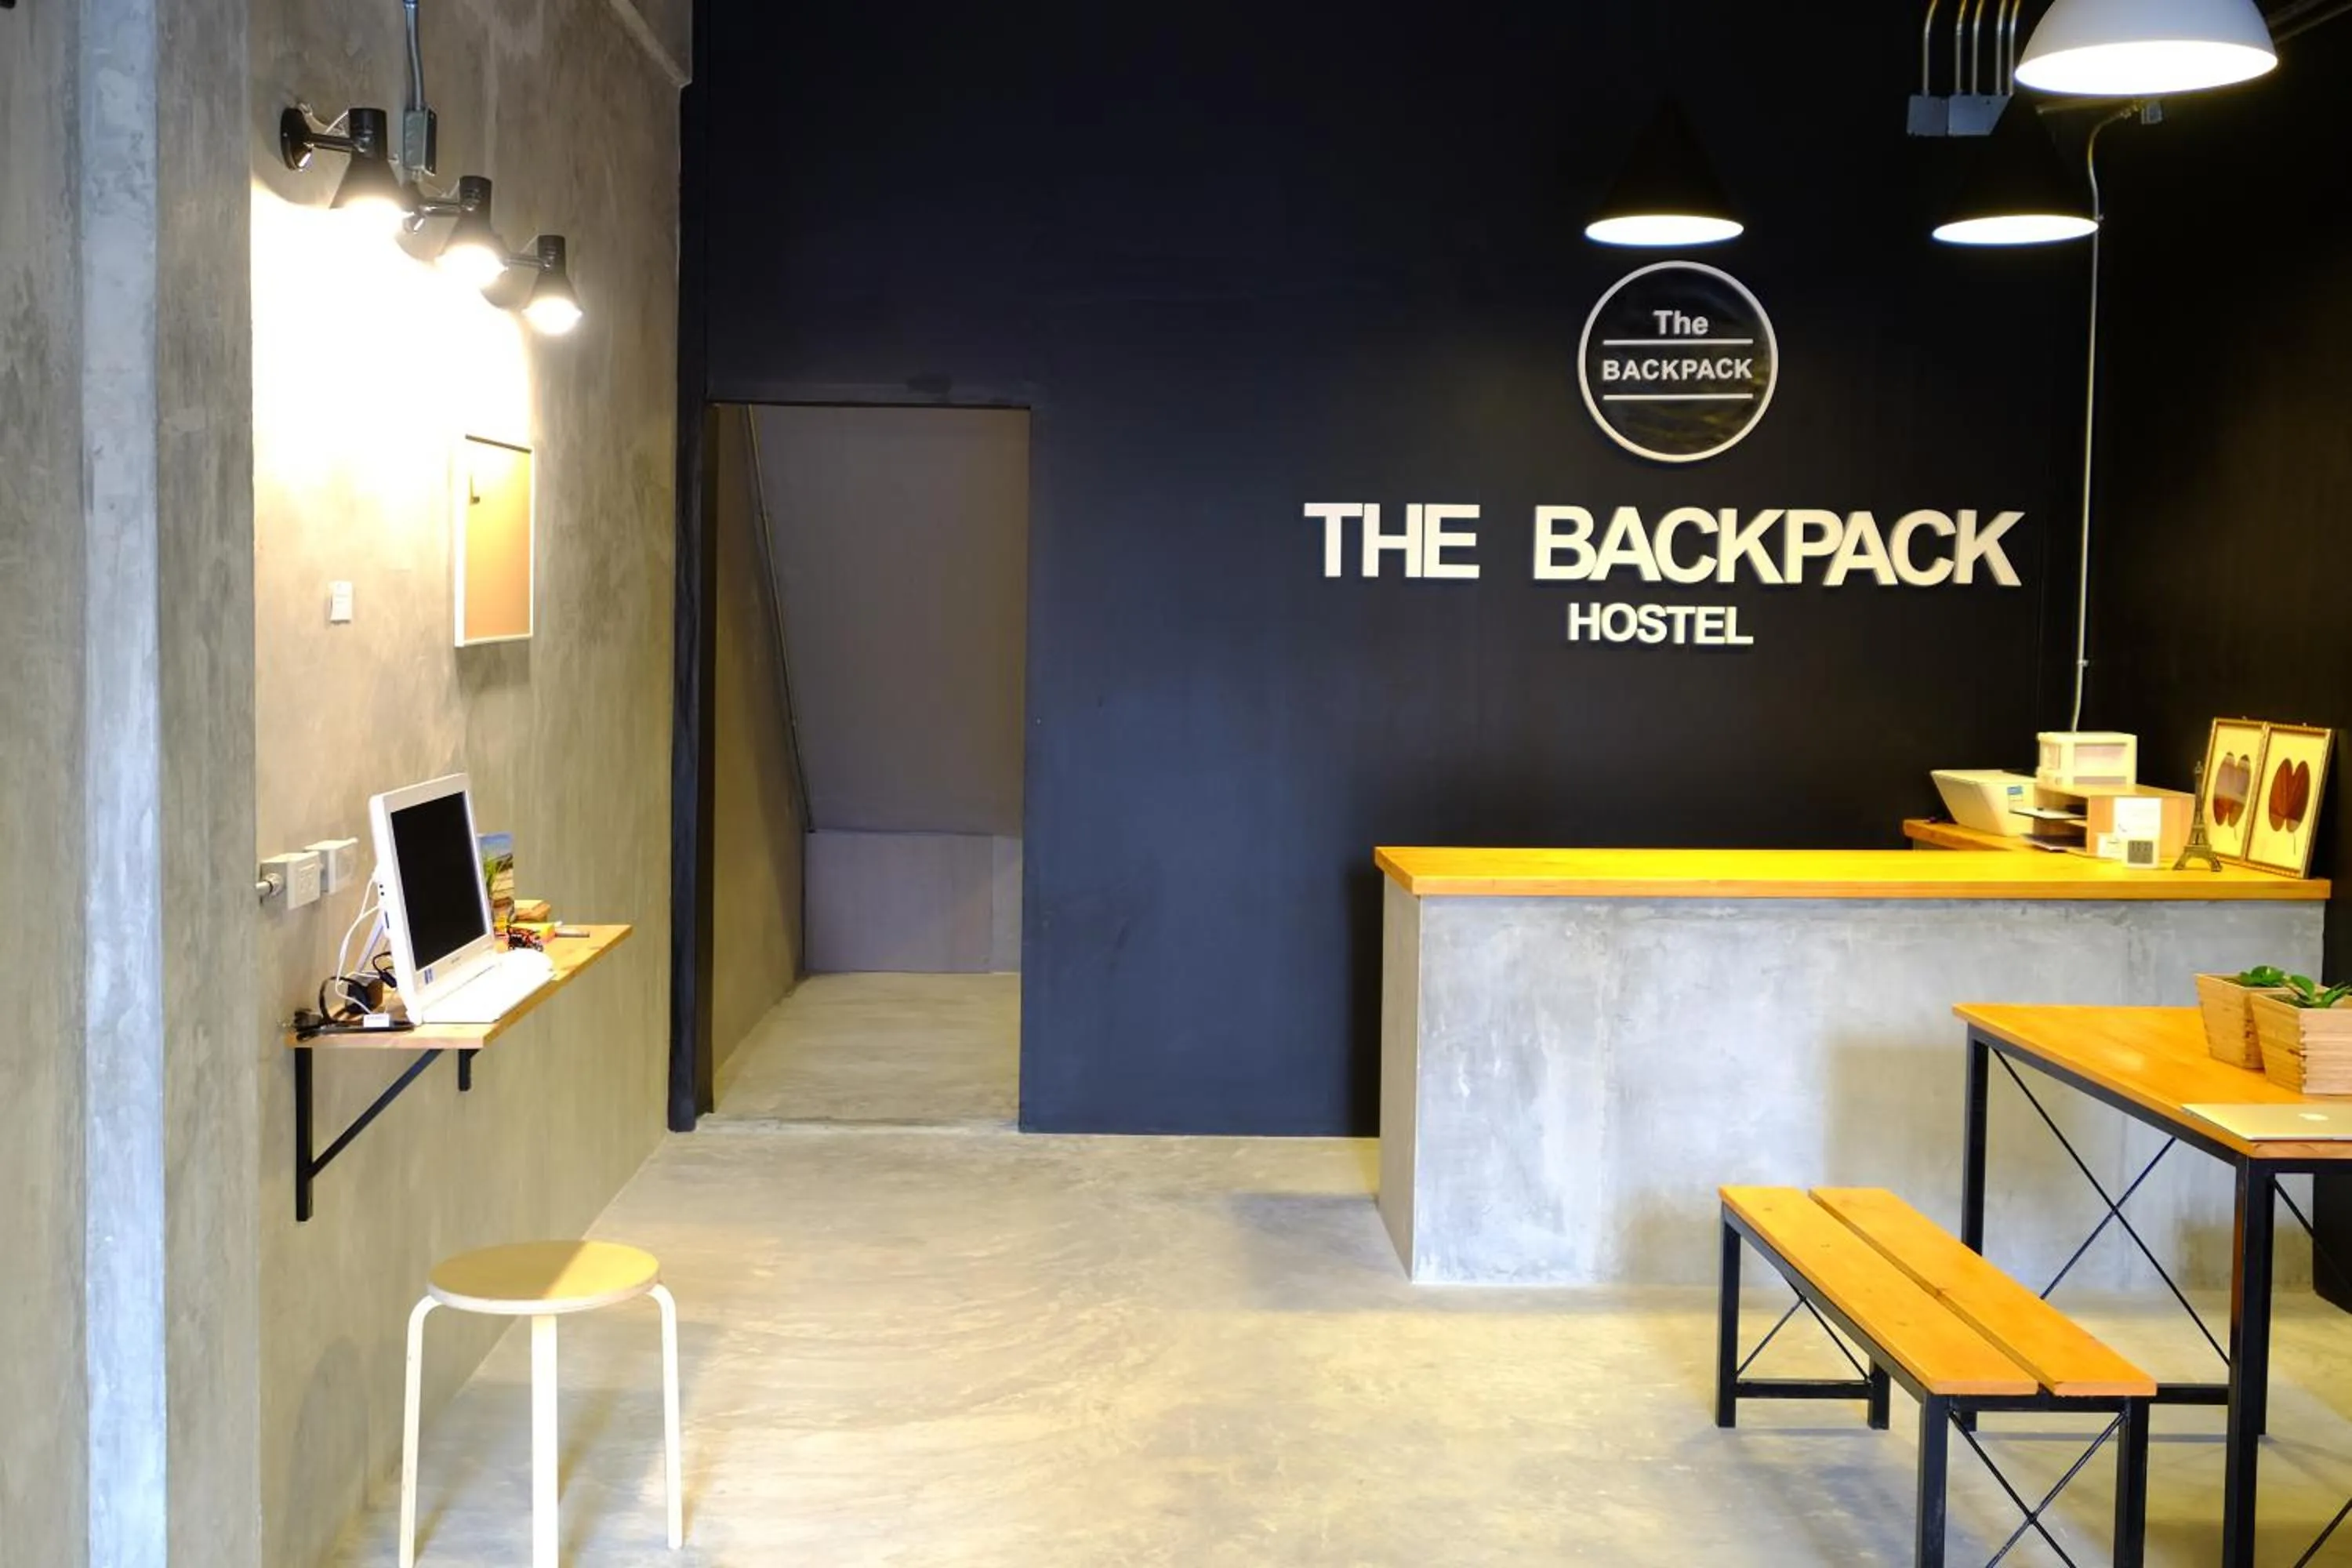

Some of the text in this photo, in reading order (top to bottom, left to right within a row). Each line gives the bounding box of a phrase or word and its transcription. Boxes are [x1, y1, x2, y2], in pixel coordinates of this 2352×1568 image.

[1653, 310, 1709, 336] The
[1602, 358, 1754, 381] BACKPACK
[1303, 502, 2025, 587] THE BACKPACK
[1567, 601, 1755, 645] HOSTEL
